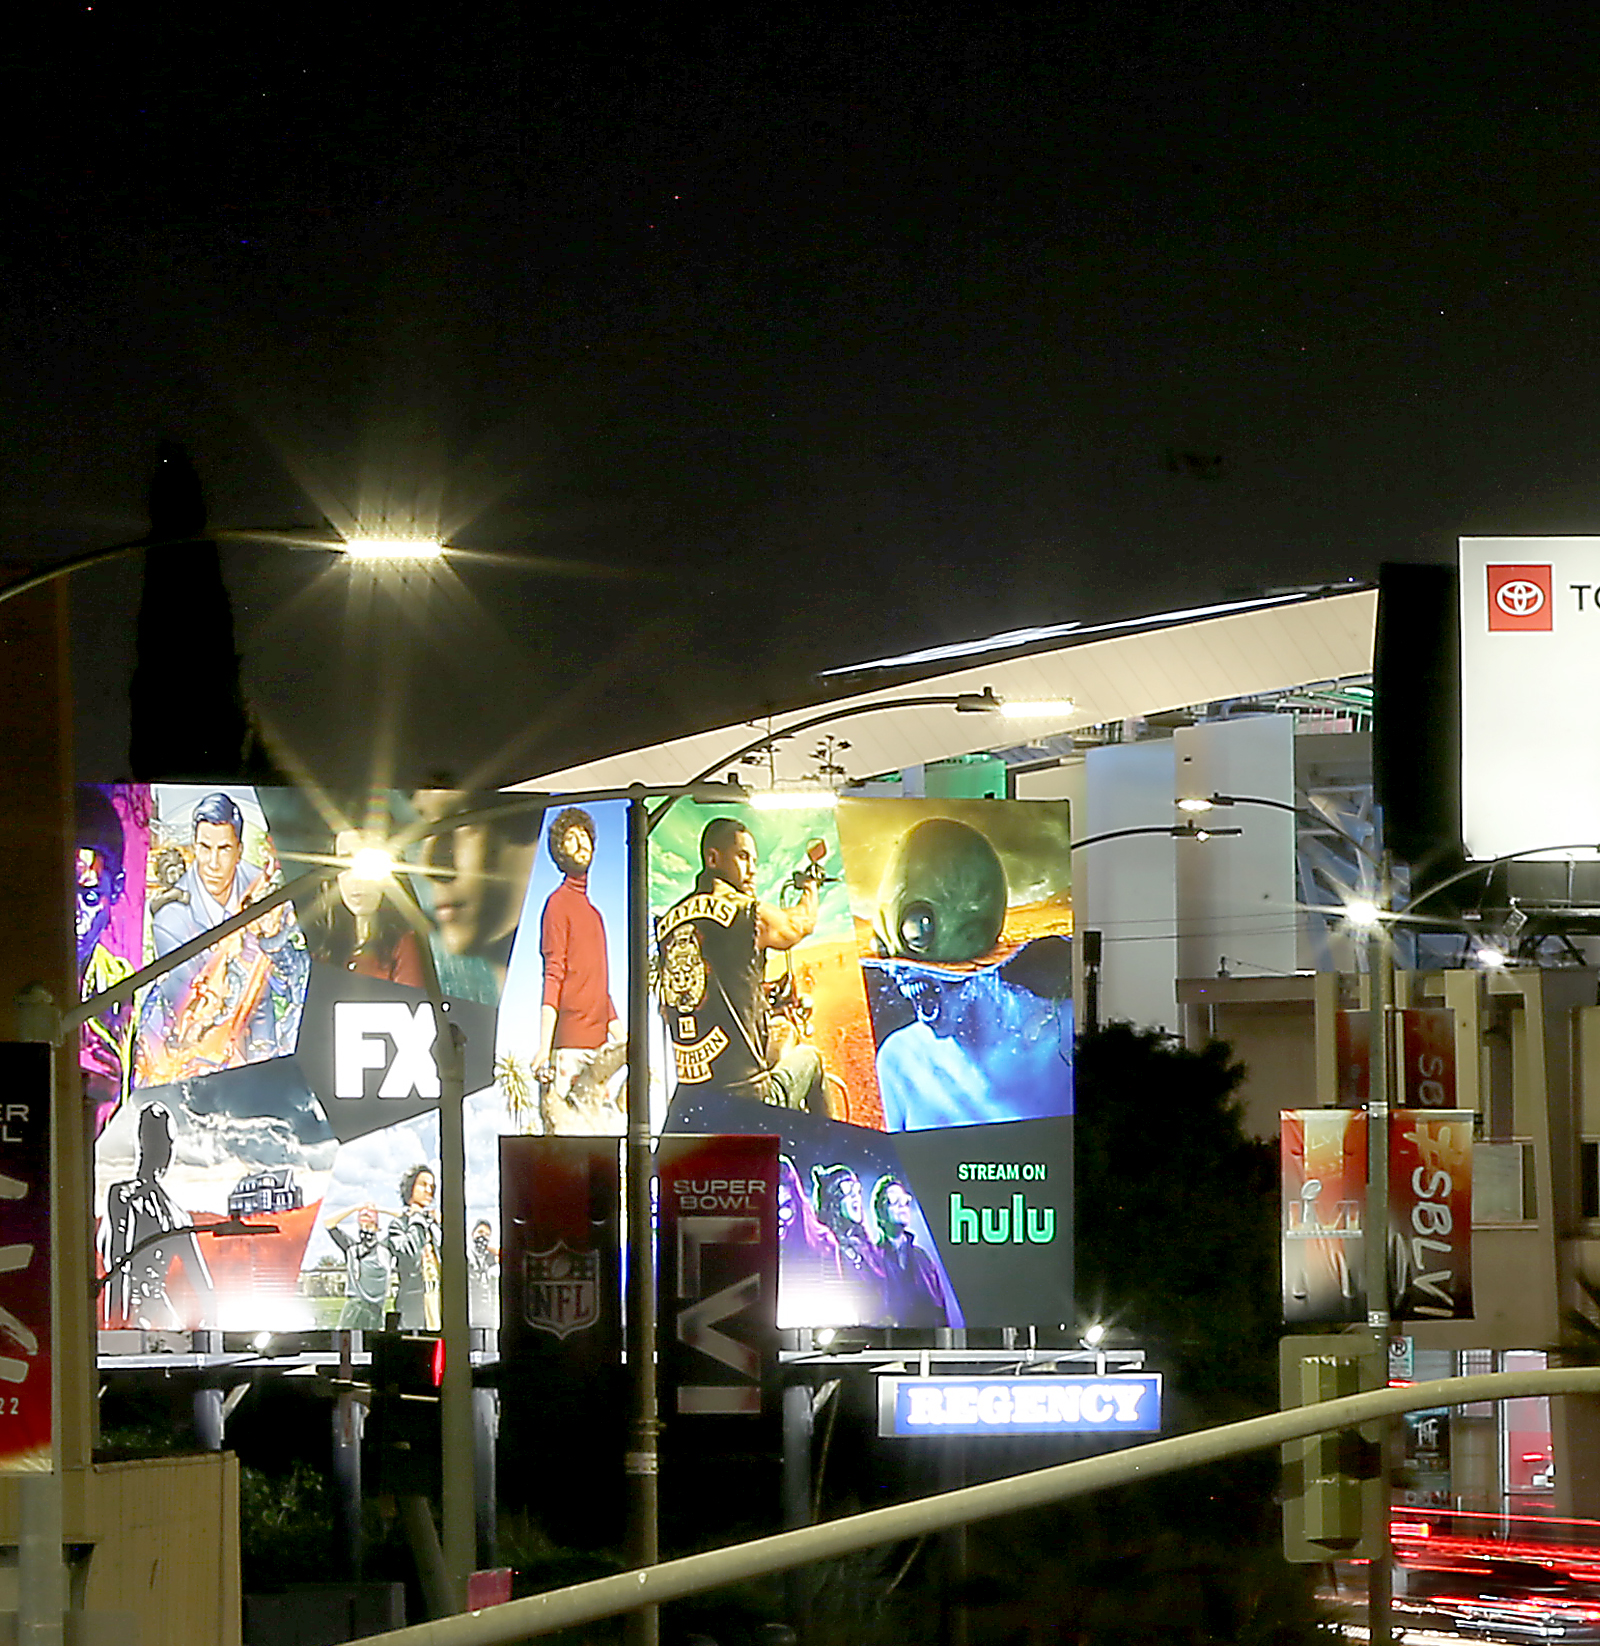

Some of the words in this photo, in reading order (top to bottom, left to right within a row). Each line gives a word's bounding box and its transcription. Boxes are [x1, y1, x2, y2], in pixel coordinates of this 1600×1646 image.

[333, 1001, 442, 1099] FX
[673, 1179, 766, 1195] SUPER
[958, 1163, 1020, 1181] STREAM
[1022, 1163, 1046, 1181] ON
[680, 1195, 759, 1210] BOWL
[949, 1193, 1056, 1244] hulu
[530, 1284, 591, 1324] NFL
[906, 1383, 1146, 1425] REGENCY
